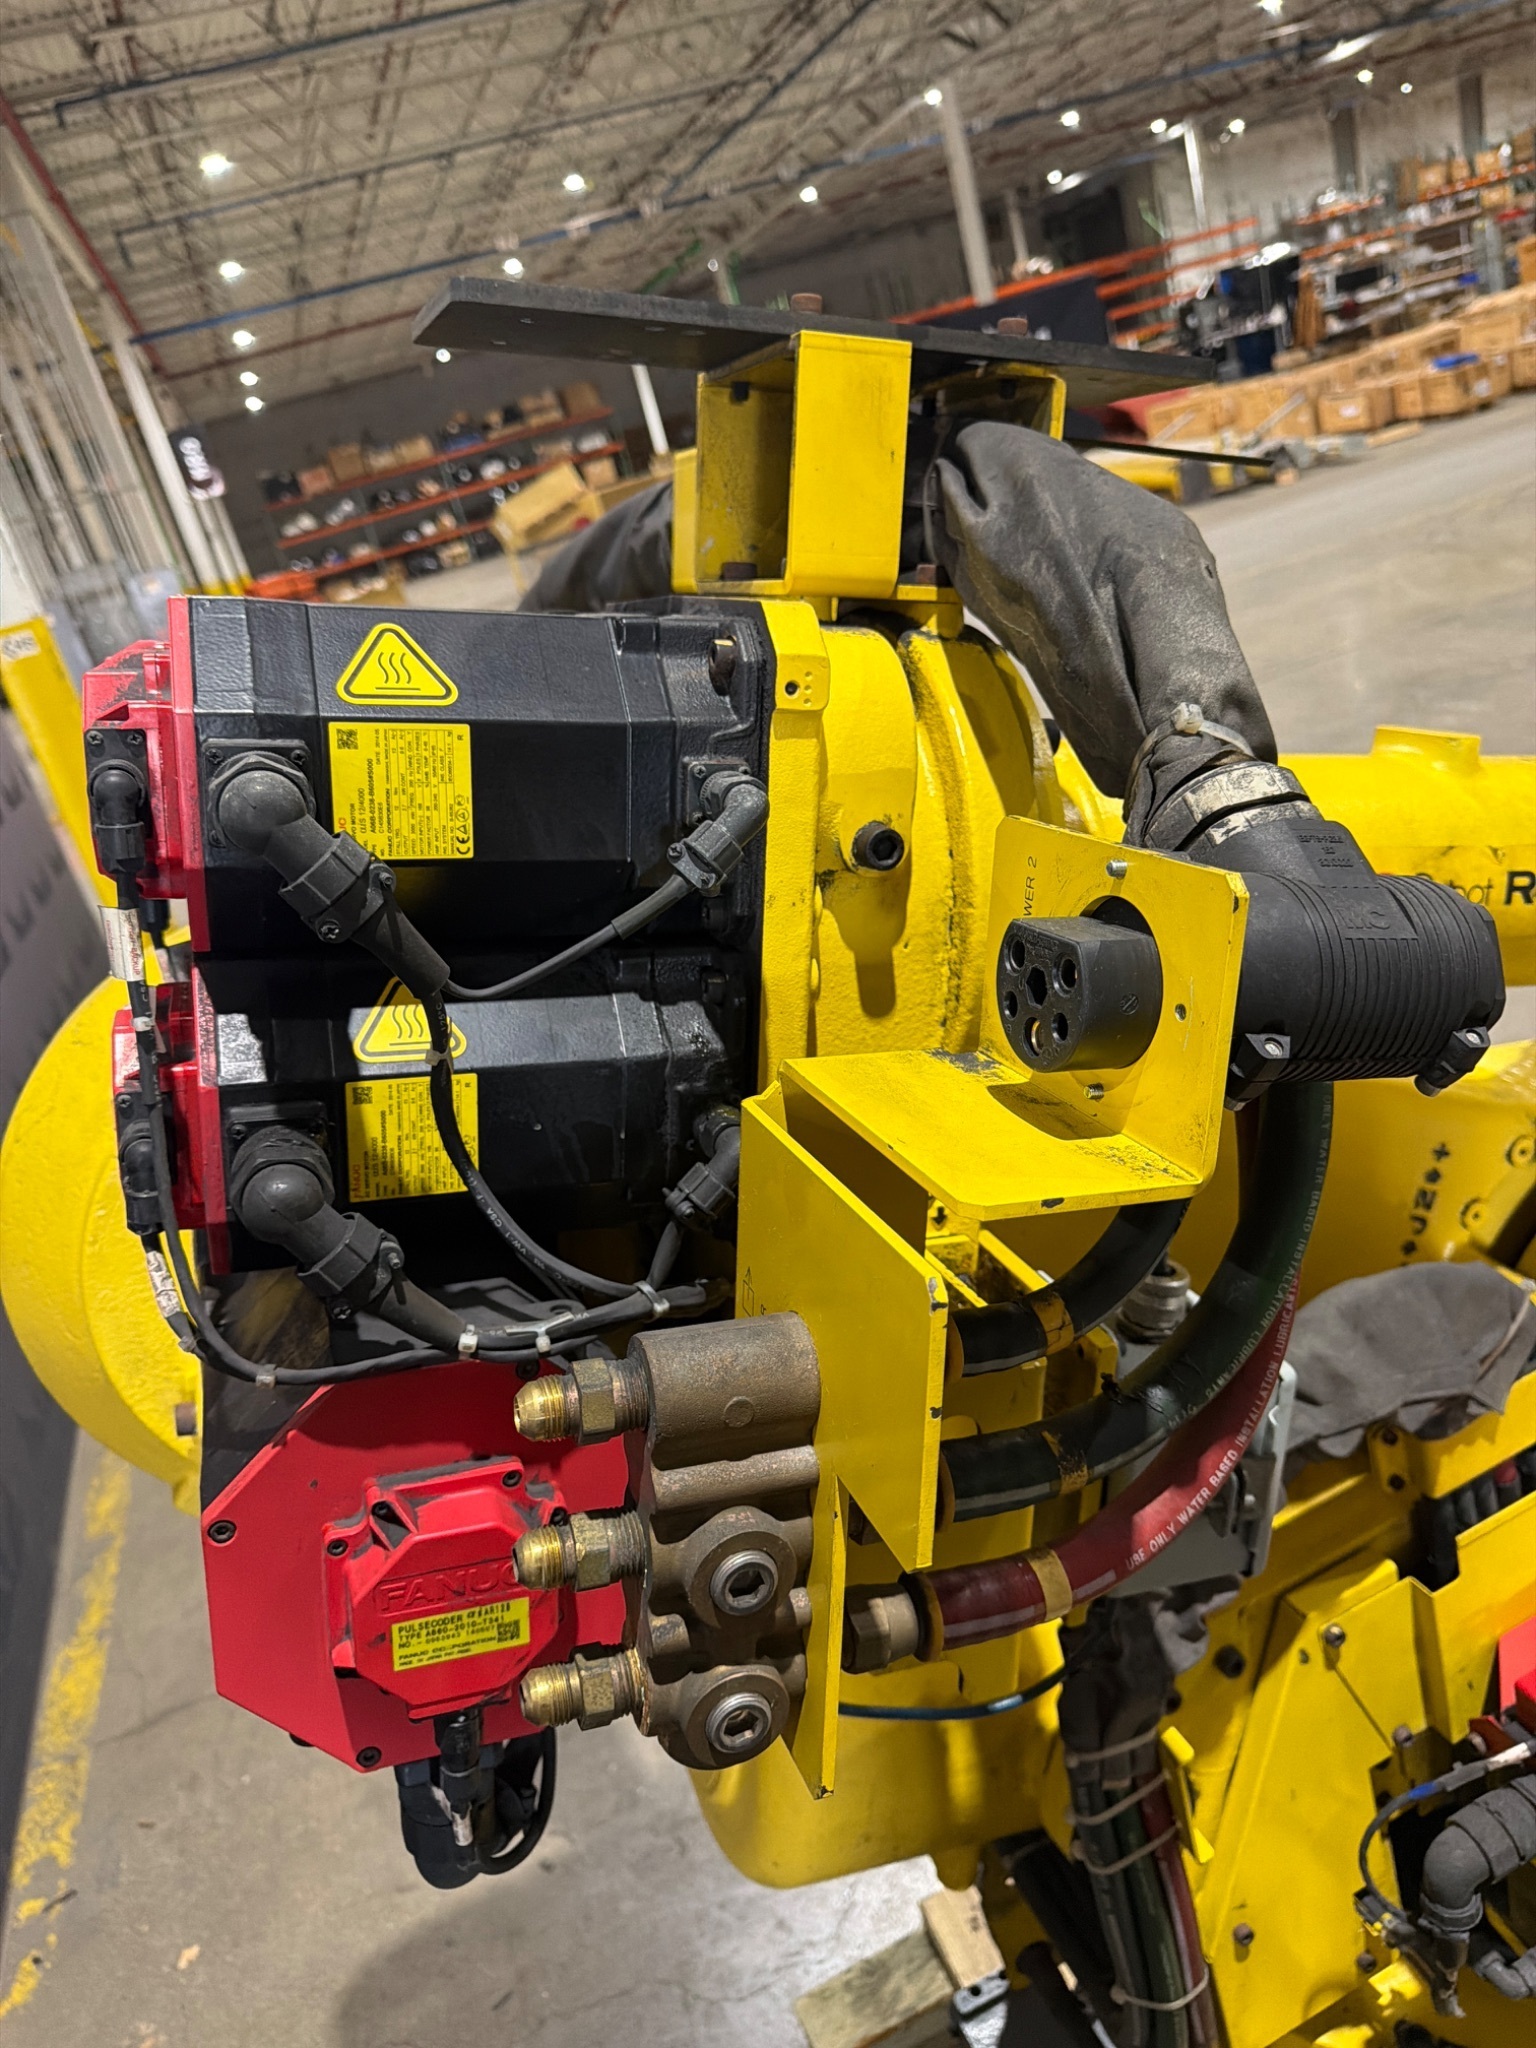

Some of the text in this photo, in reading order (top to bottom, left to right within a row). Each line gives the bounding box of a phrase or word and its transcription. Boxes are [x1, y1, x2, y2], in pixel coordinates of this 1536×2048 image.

[1023, 856, 1037, 917] WER 2
[1125, 1548, 1146, 1571] USE
[1149, 1521, 1176, 1552] ONLY
[1176, 1486, 1212, 1525] WATER
[1208, 1449, 1239, 1487] BASED
[1234, 1360, 1280, 1448] INSTALLATION
[398, 1614, 463, 1635] PULSECODER
[399, 1630, 422, 1642] TYPE
